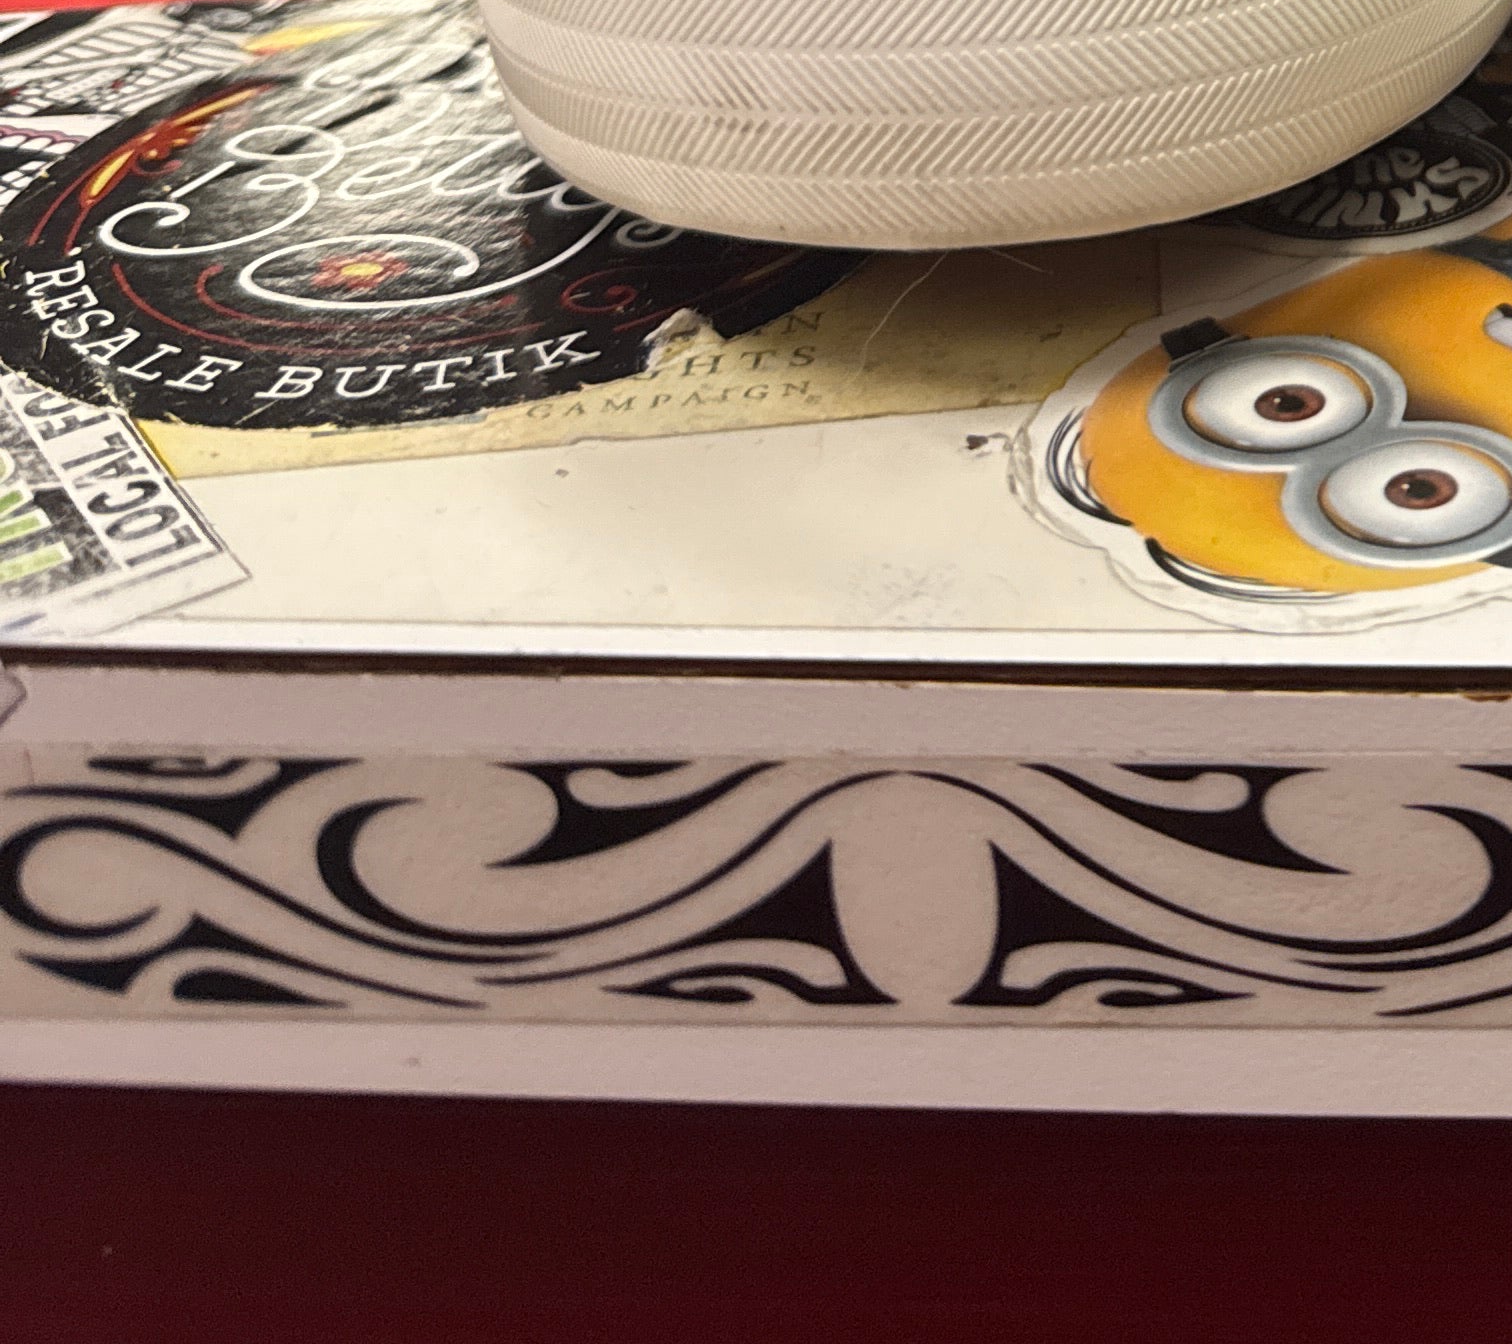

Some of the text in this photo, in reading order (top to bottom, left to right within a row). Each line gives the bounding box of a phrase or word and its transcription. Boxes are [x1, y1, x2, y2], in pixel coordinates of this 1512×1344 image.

[1278, 155, 1491, 228] INKS
[24, 259, 602, 400] RESALE BUTIK
[526, 379, 811, 420] CAMPAIGN
[62, 430, 204, 567] LOCAL
